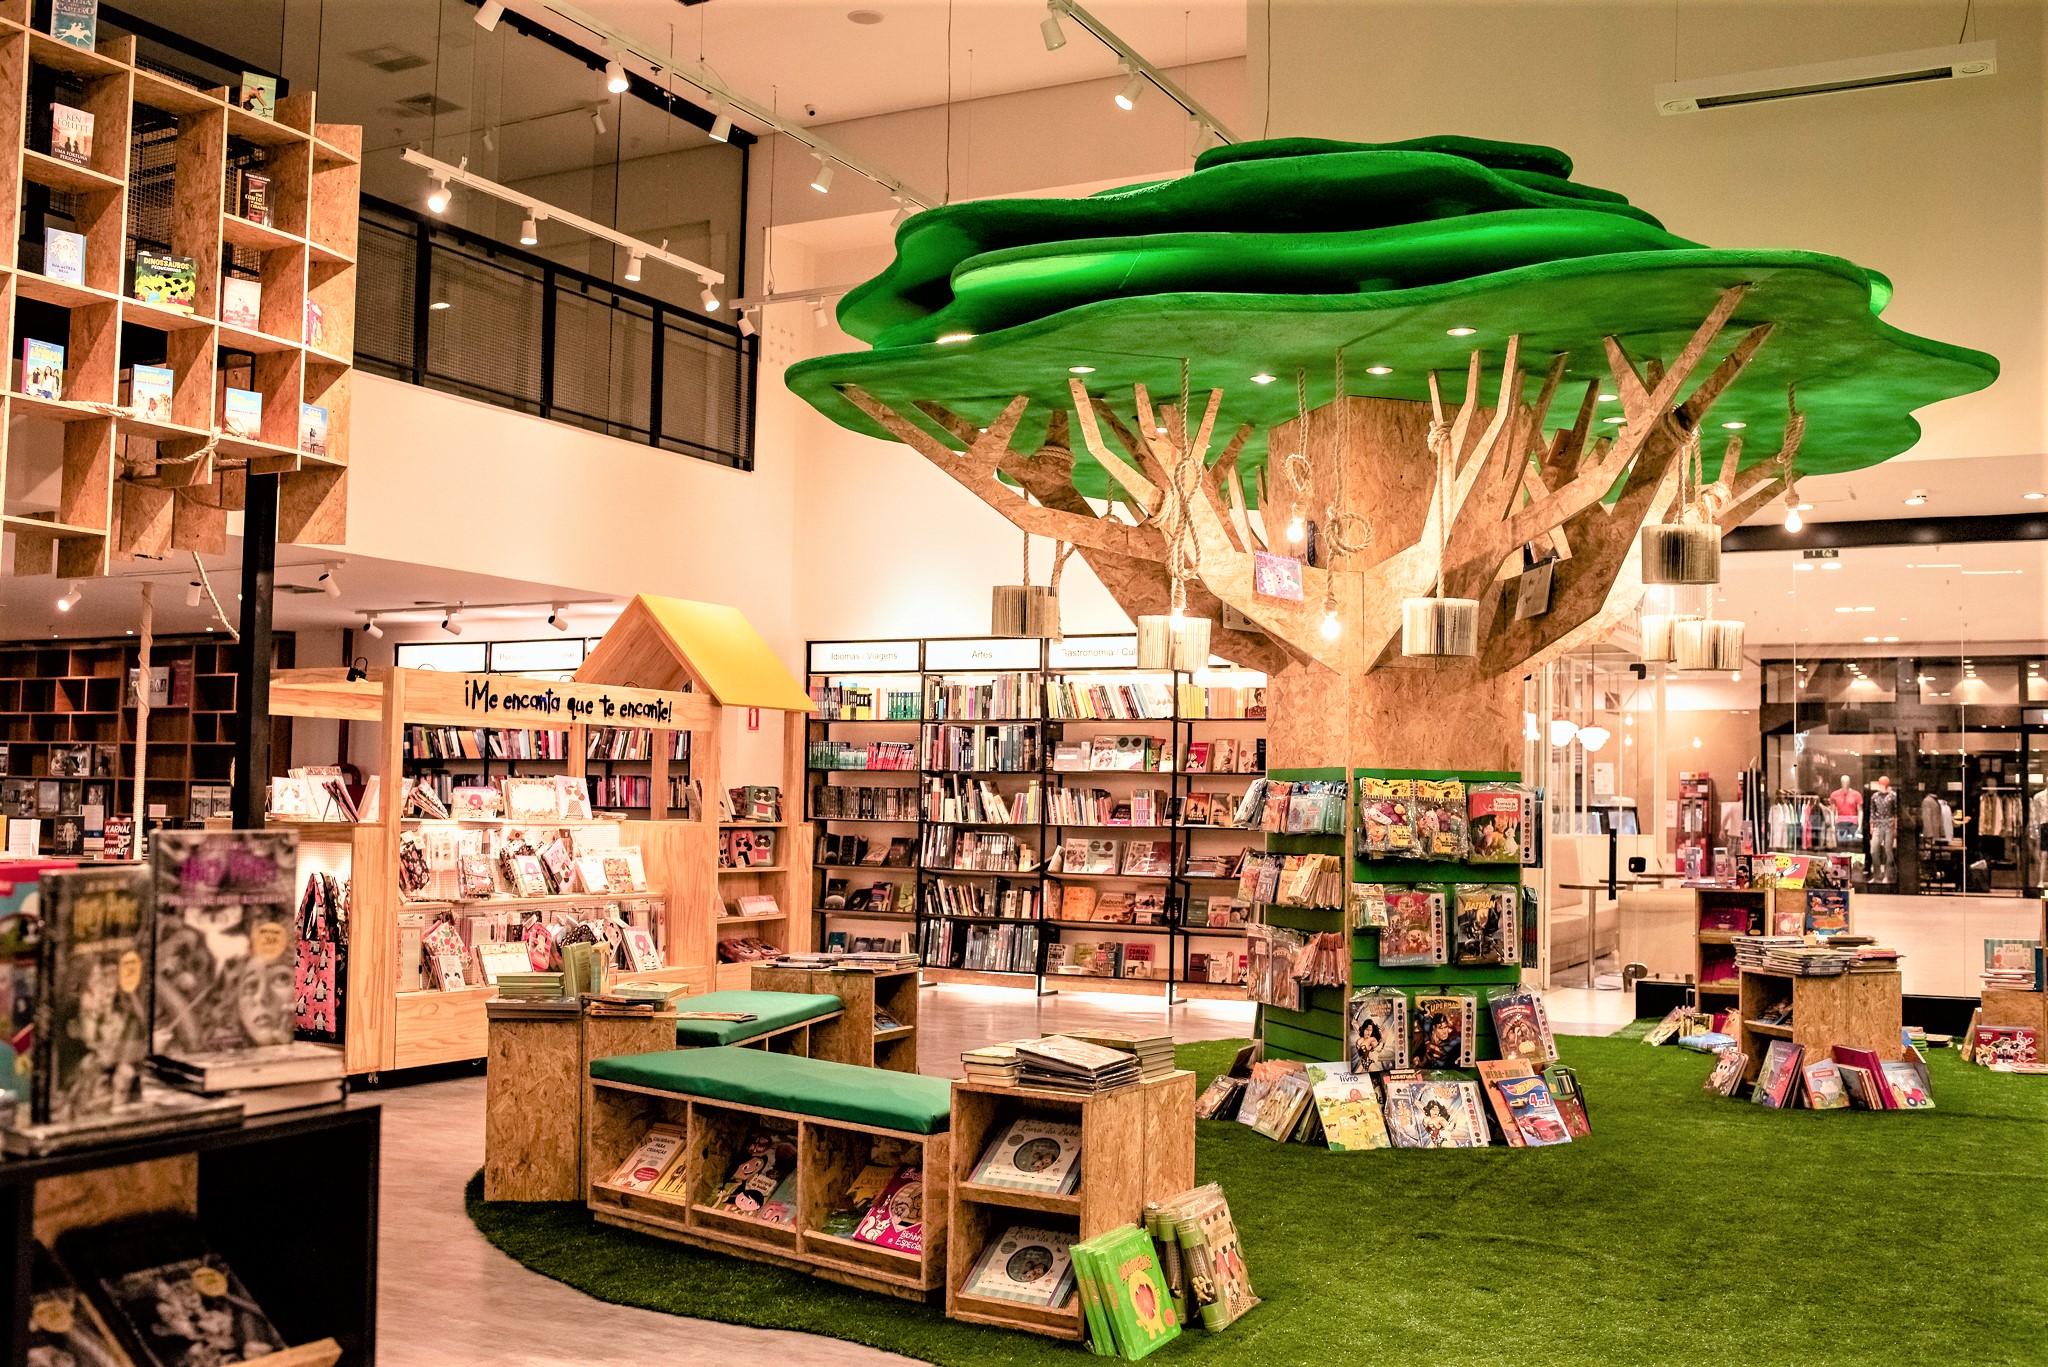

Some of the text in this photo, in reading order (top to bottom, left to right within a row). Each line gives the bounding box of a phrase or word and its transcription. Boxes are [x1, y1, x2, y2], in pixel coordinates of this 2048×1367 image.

[66, 113, 82, 123] KEN
[57, 117, 88, 133] FOLLETT
[143, 257, 190, 270] DINOSSAUROS
[831, 652, 860, 660] Idiomas
[867, 651, 898, 662] Viagens
[971, 650, 993, 659] Artes
[502, 688, 560, 715] encanta
[567, 697, 594, 720] que
[599, 694, 615, 718] te
[619, 697, 673, 723] encante!
[104, 847, 128, 856] HAMLET
[1464, 900, 1496, 911] BATMAN
[1424, 1001, 1461, 1016] SUPERMAN
[1339, 1074, 1359, 1083] livro
[1529, 1094, 1538, 1107] 4
[1544, 1092, 1550, 1105] 1
